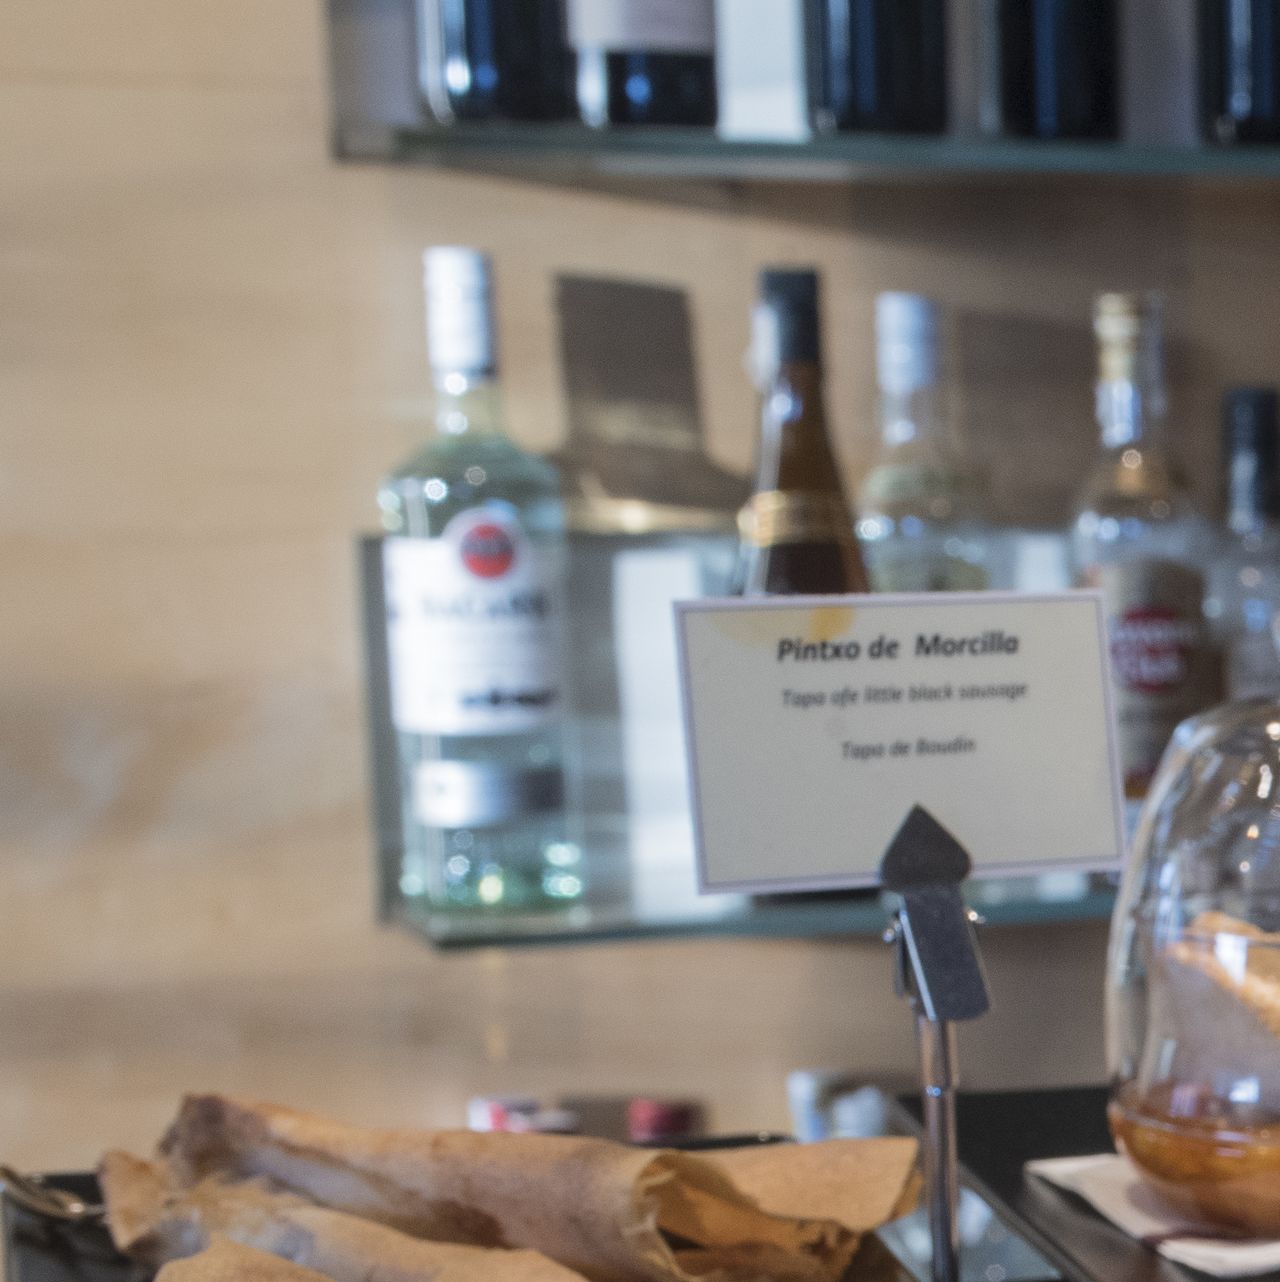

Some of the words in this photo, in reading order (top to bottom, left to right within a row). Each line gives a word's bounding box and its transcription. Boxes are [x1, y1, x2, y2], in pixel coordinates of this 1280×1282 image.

[778, 638, 860, 663] Pintxo
[868, 636, 898, 660] de
[915, 632, 1019, 658] Morcilla
[889, 741, 910, 757] de
